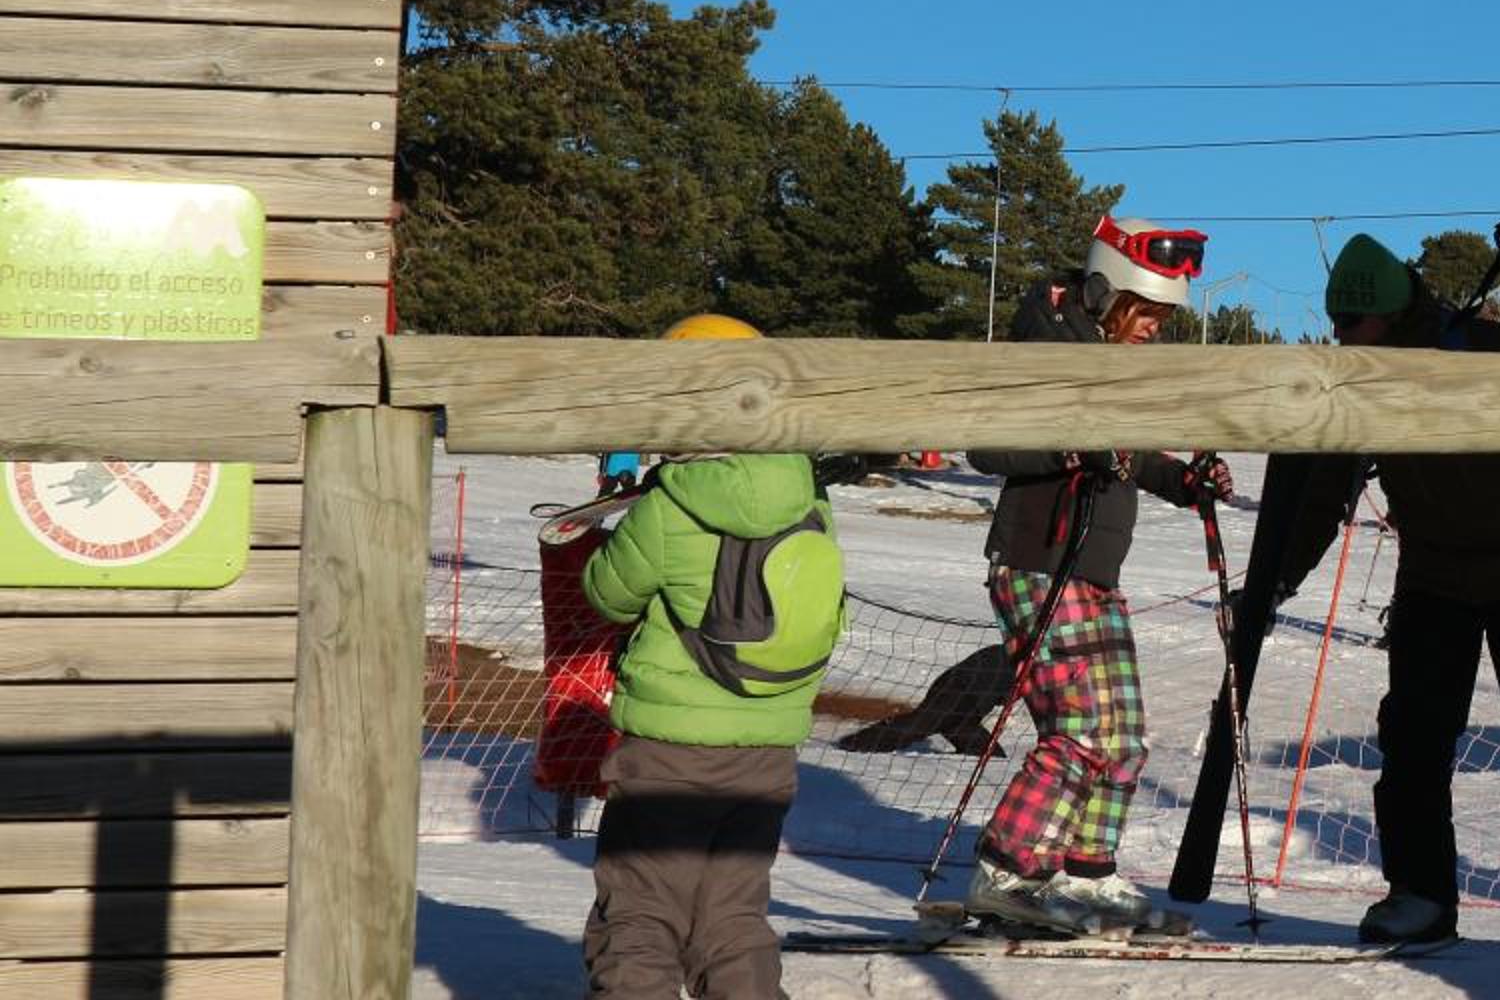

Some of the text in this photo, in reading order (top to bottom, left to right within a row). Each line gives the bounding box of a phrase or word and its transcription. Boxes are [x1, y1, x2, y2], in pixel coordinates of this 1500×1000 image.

[0, 262, 244, 296] Prohibido el acceso
[21, 308, 114, 332] trineos
[121, 311, 135, 337] y
[142, 307, 258, 337] plásticos
